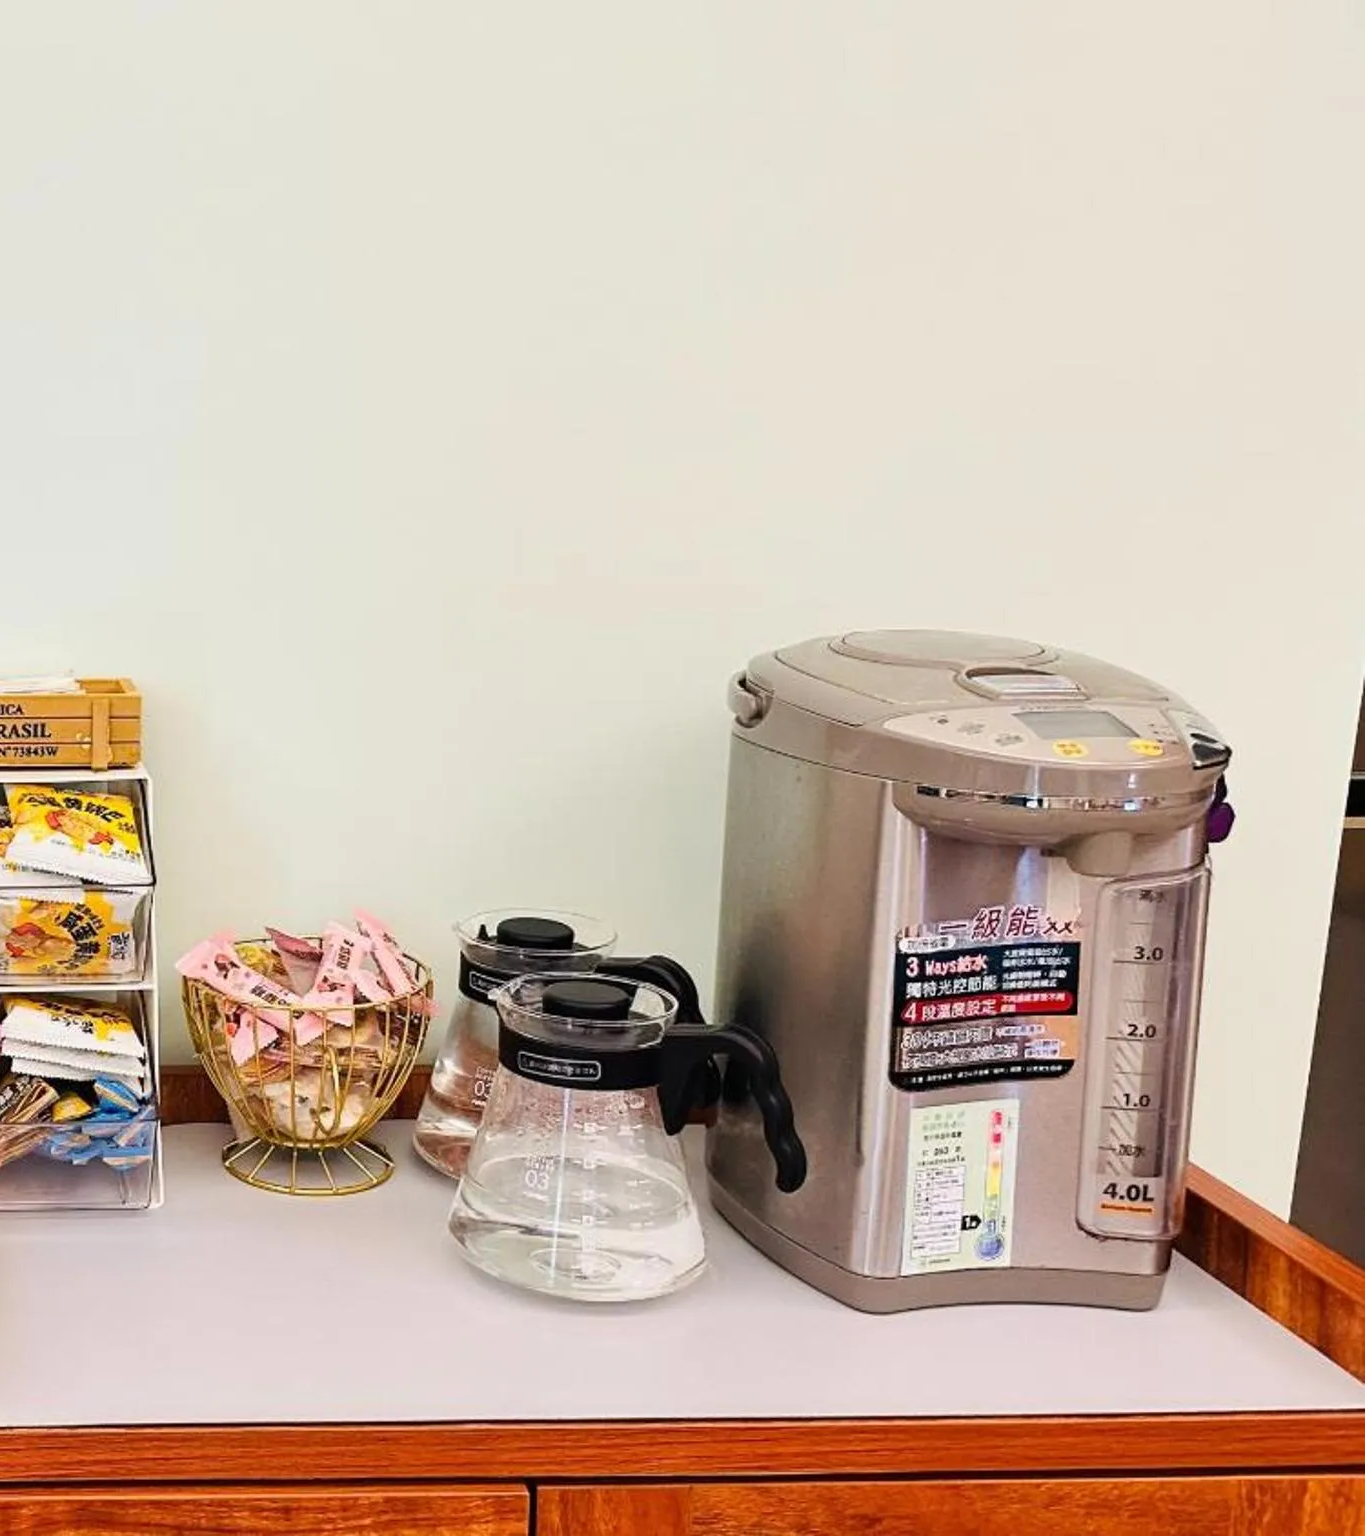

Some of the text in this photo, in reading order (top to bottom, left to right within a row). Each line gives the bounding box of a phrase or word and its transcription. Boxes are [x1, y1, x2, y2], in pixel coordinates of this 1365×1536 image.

[1133, 946, 1164, 961] 3.0
[906, 957, 920, 977] 3
[904, 1003, 918, 1022] 4
[1127, 1024, 1157, 1038] 2.0
[1123, 1093, 1151, 1108] 1.0
[1103, 1183, 1155, 1202] 4.0L
